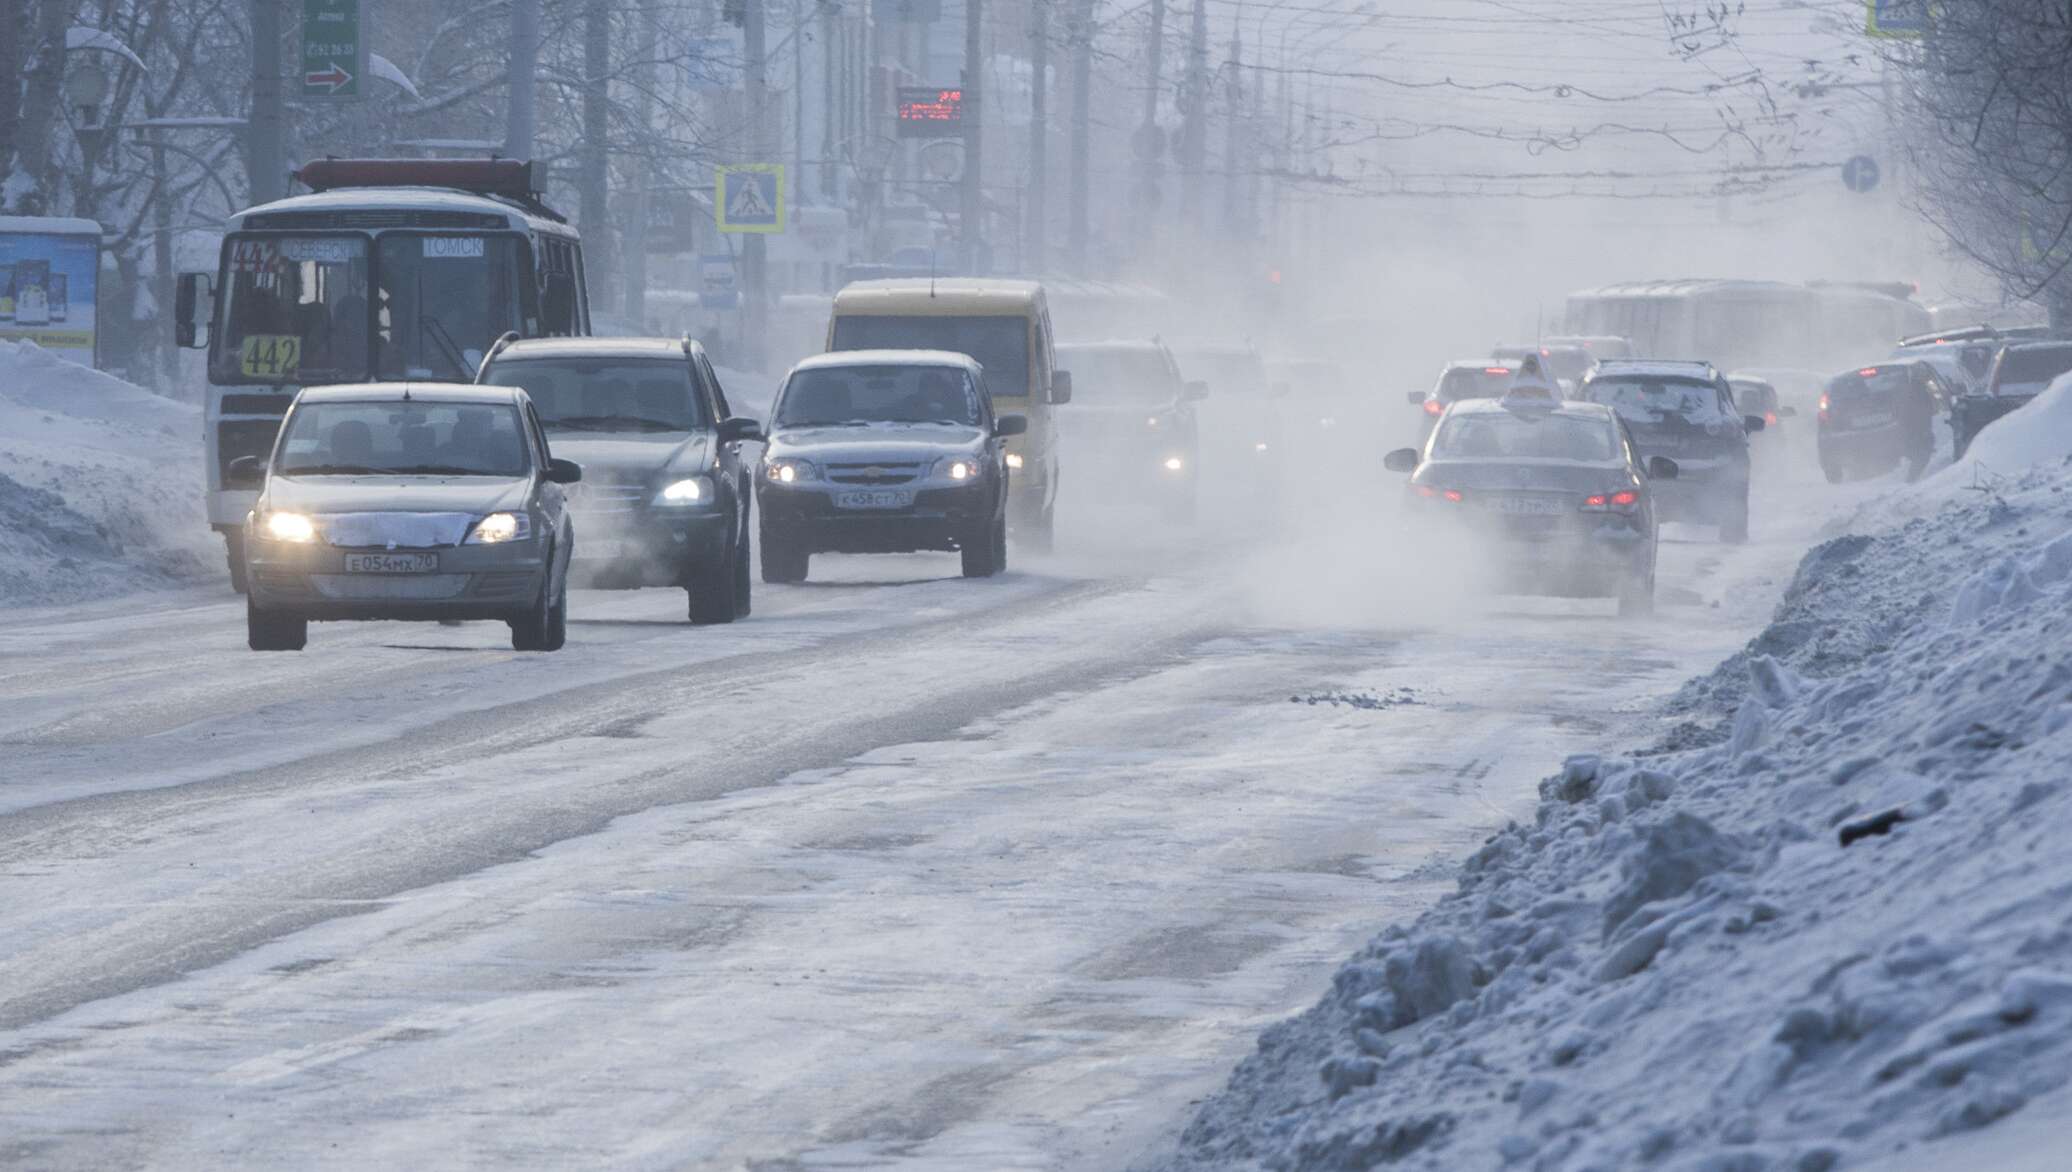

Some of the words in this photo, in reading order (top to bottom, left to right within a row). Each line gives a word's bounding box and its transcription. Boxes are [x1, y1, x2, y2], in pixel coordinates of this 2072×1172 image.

[233, 241, 280, 273] 442
[426, 239, 482, 254] ТОМСК
[245, 339, 297, 376] 442
[352, 555, 414, 572] Е054МХ
[416, 554, 434, 569] 70
